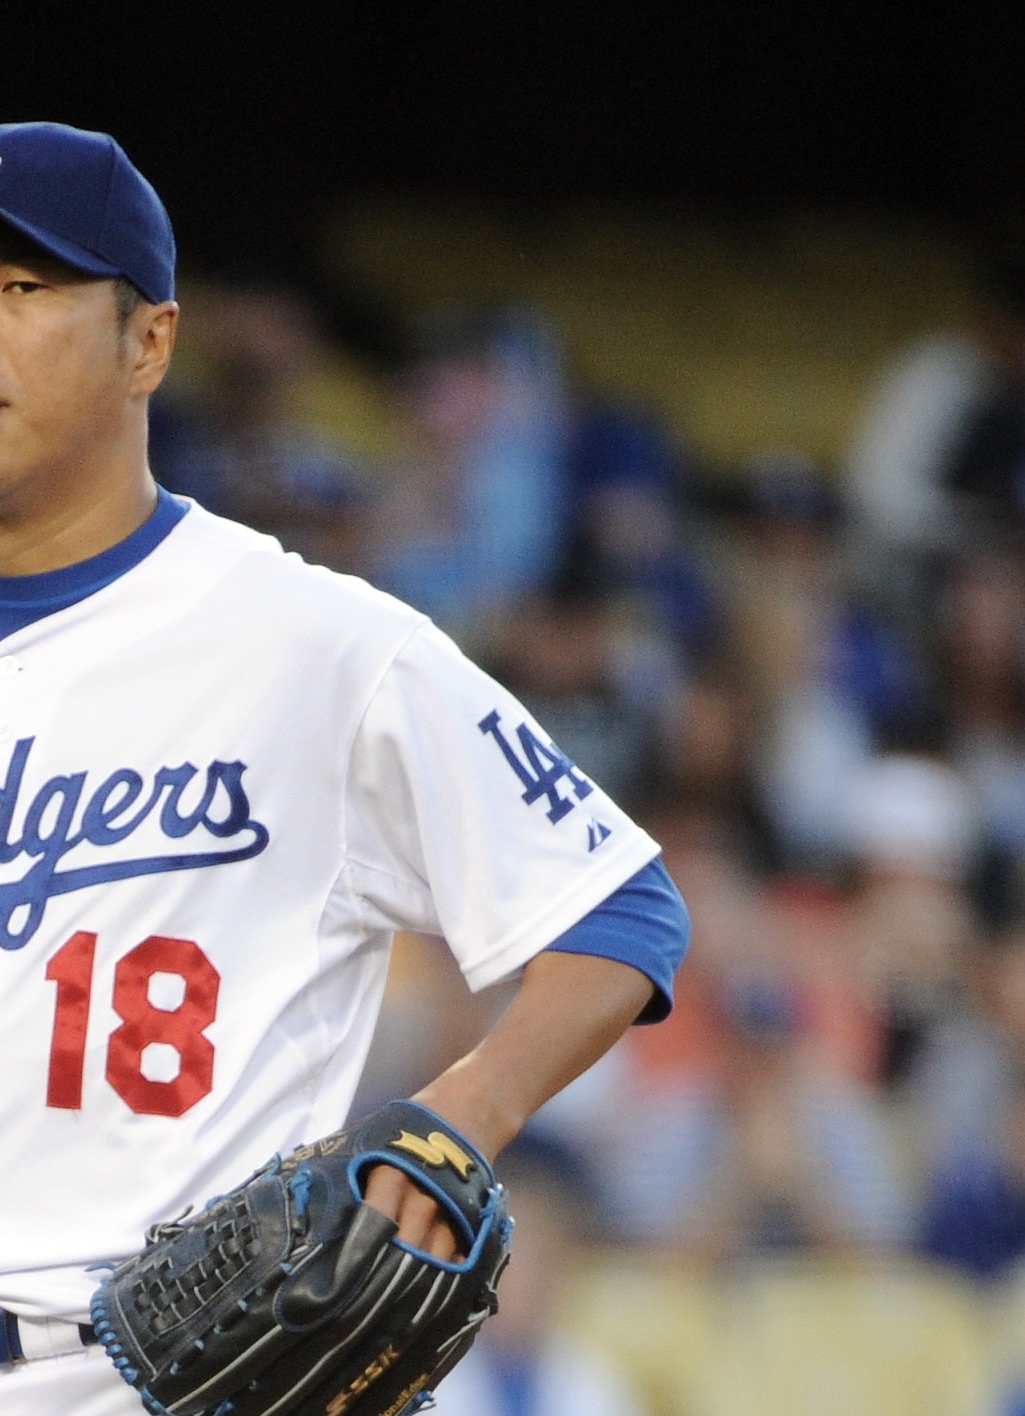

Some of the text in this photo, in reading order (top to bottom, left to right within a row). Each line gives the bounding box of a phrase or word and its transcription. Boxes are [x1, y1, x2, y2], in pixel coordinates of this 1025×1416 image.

[477, 708, 594, 826] LA
[45, 930, 221, 1119] 18
[349, 1344, 398, 1394] SSK
